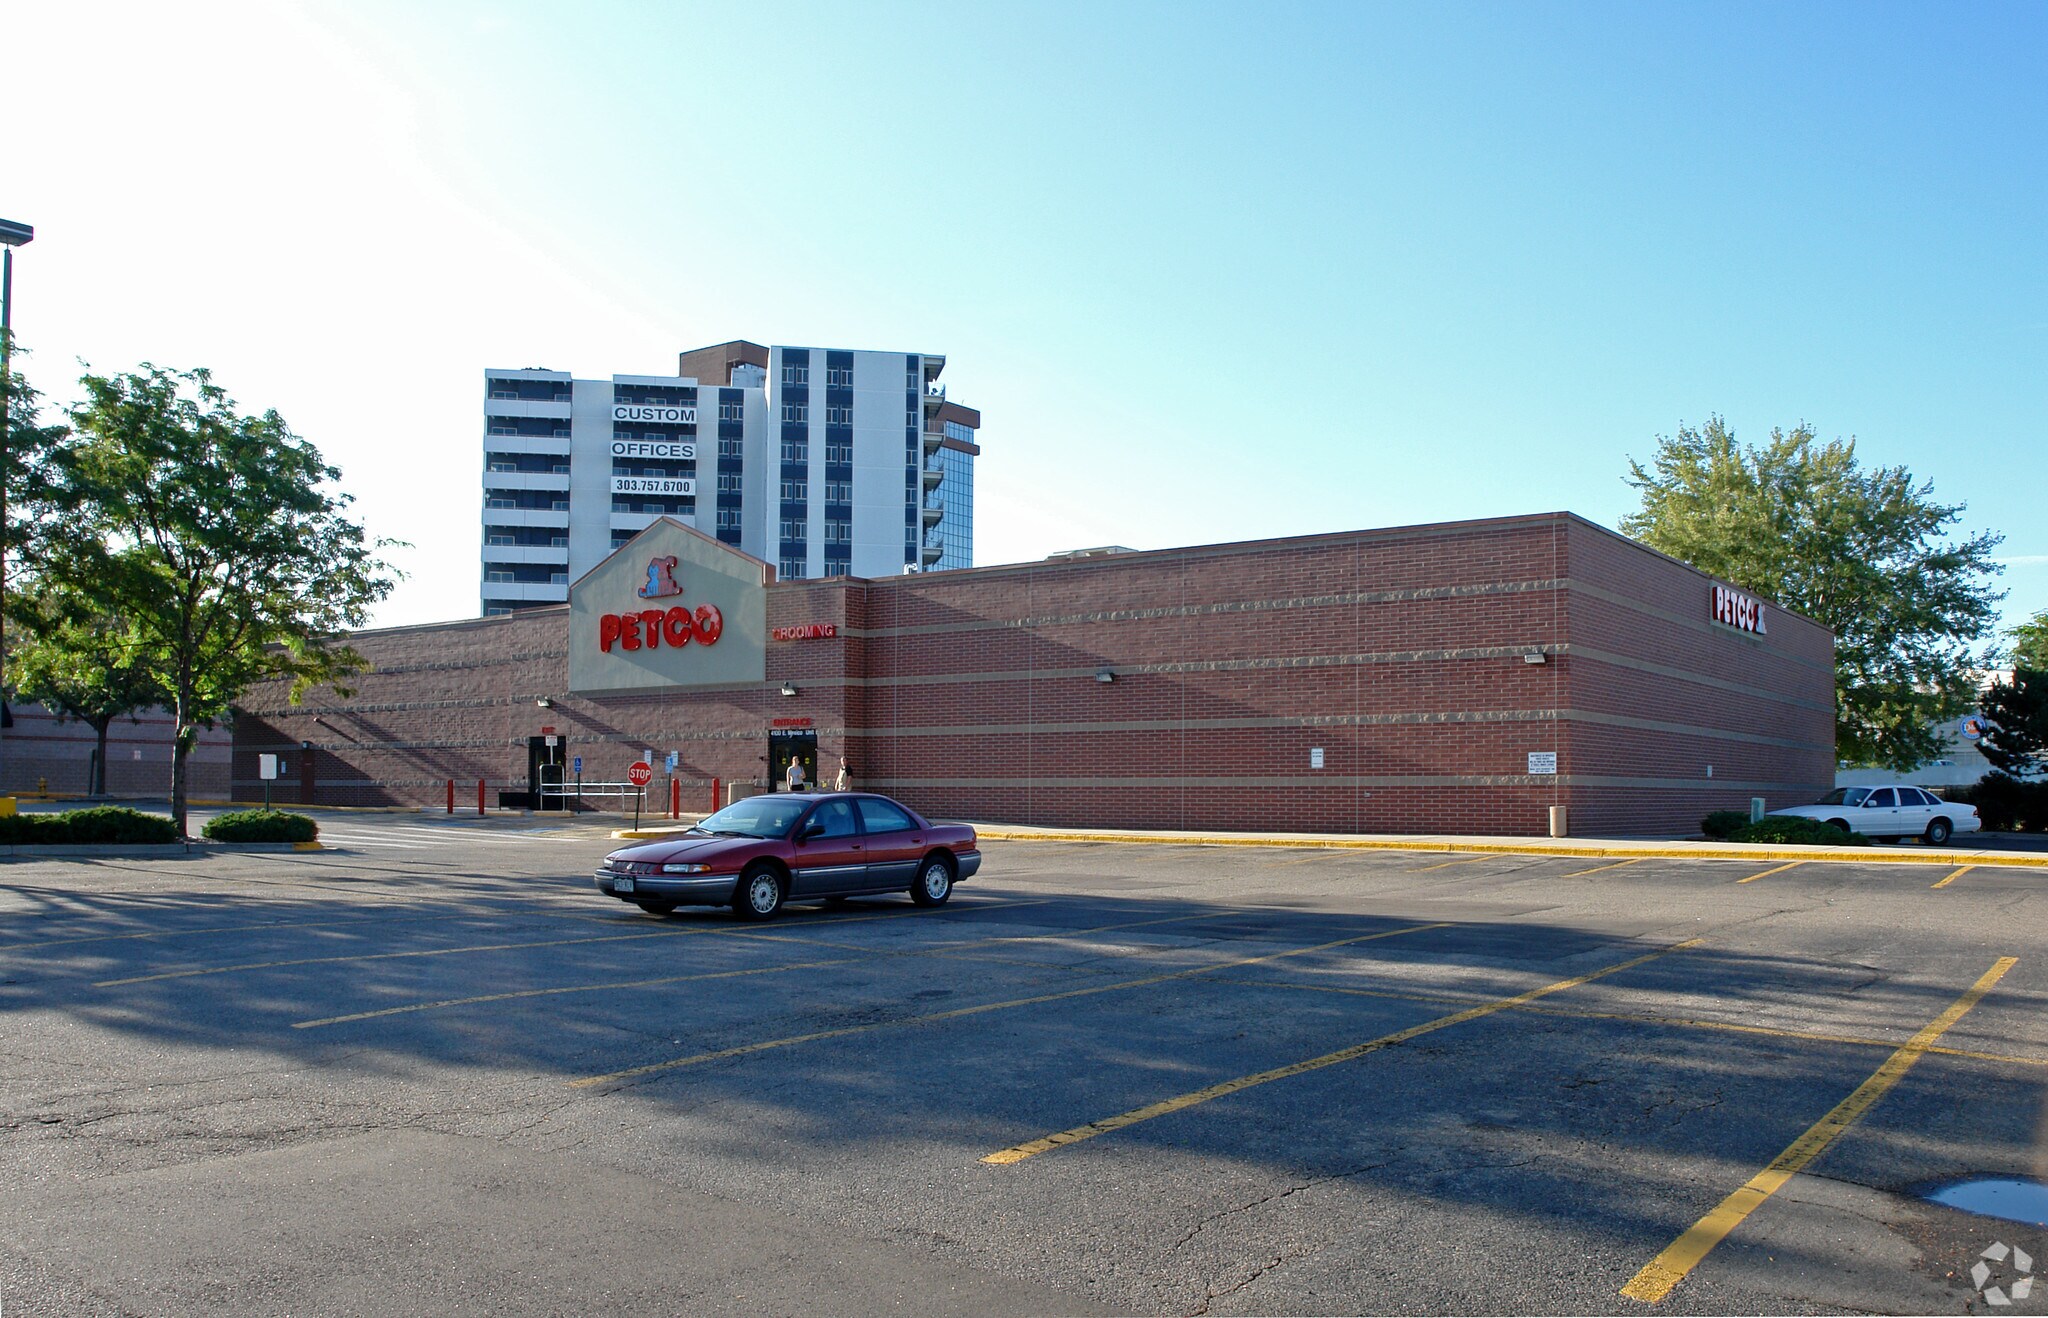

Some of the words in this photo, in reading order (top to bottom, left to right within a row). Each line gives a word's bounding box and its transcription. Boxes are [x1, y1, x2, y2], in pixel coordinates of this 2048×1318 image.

[615, 407, 694, 421] CUSTOM
[612, 443, 693, 457] OFFICES
[616, 480, 690, 492] 303.757.6700
[1712, 586, 1755, 632] PETCO
[600, 604, 723, 652] PETCO
[629, 768, 651, 780] STOP
